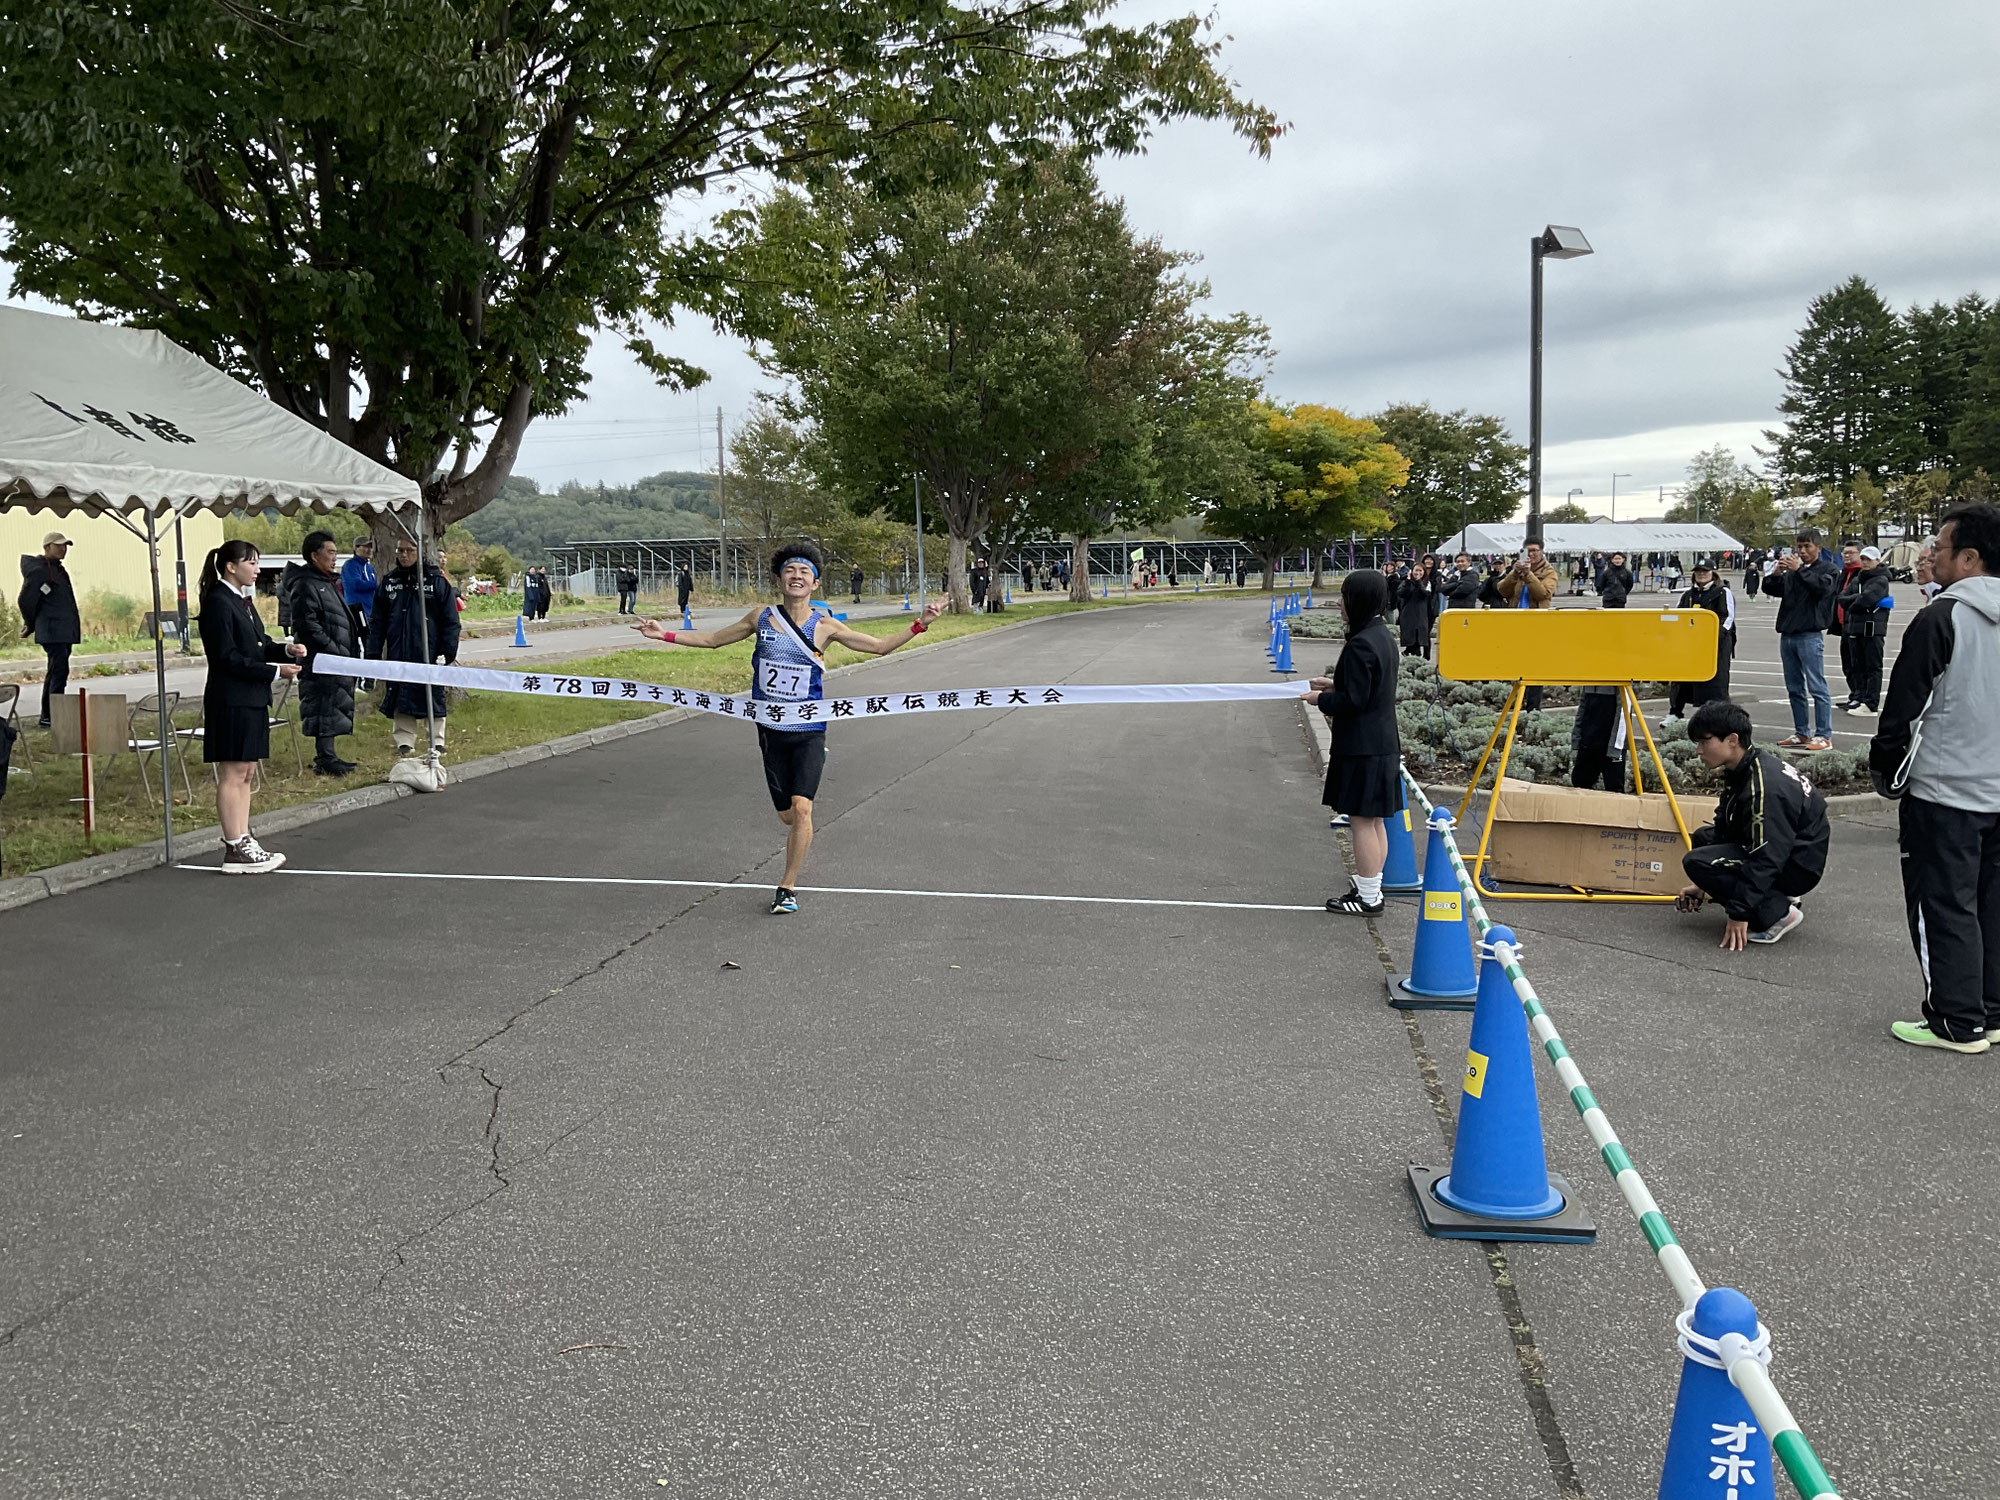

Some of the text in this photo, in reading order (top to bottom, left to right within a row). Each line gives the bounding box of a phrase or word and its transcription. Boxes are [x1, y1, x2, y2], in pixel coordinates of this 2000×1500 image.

[766, 668, 800, 692] 2-7
[522, 675, 1064, 724] 第78回男子北海道高等学校駅伝競走大会
[1600, 830, 1677, 844] SPORTS TIMER
